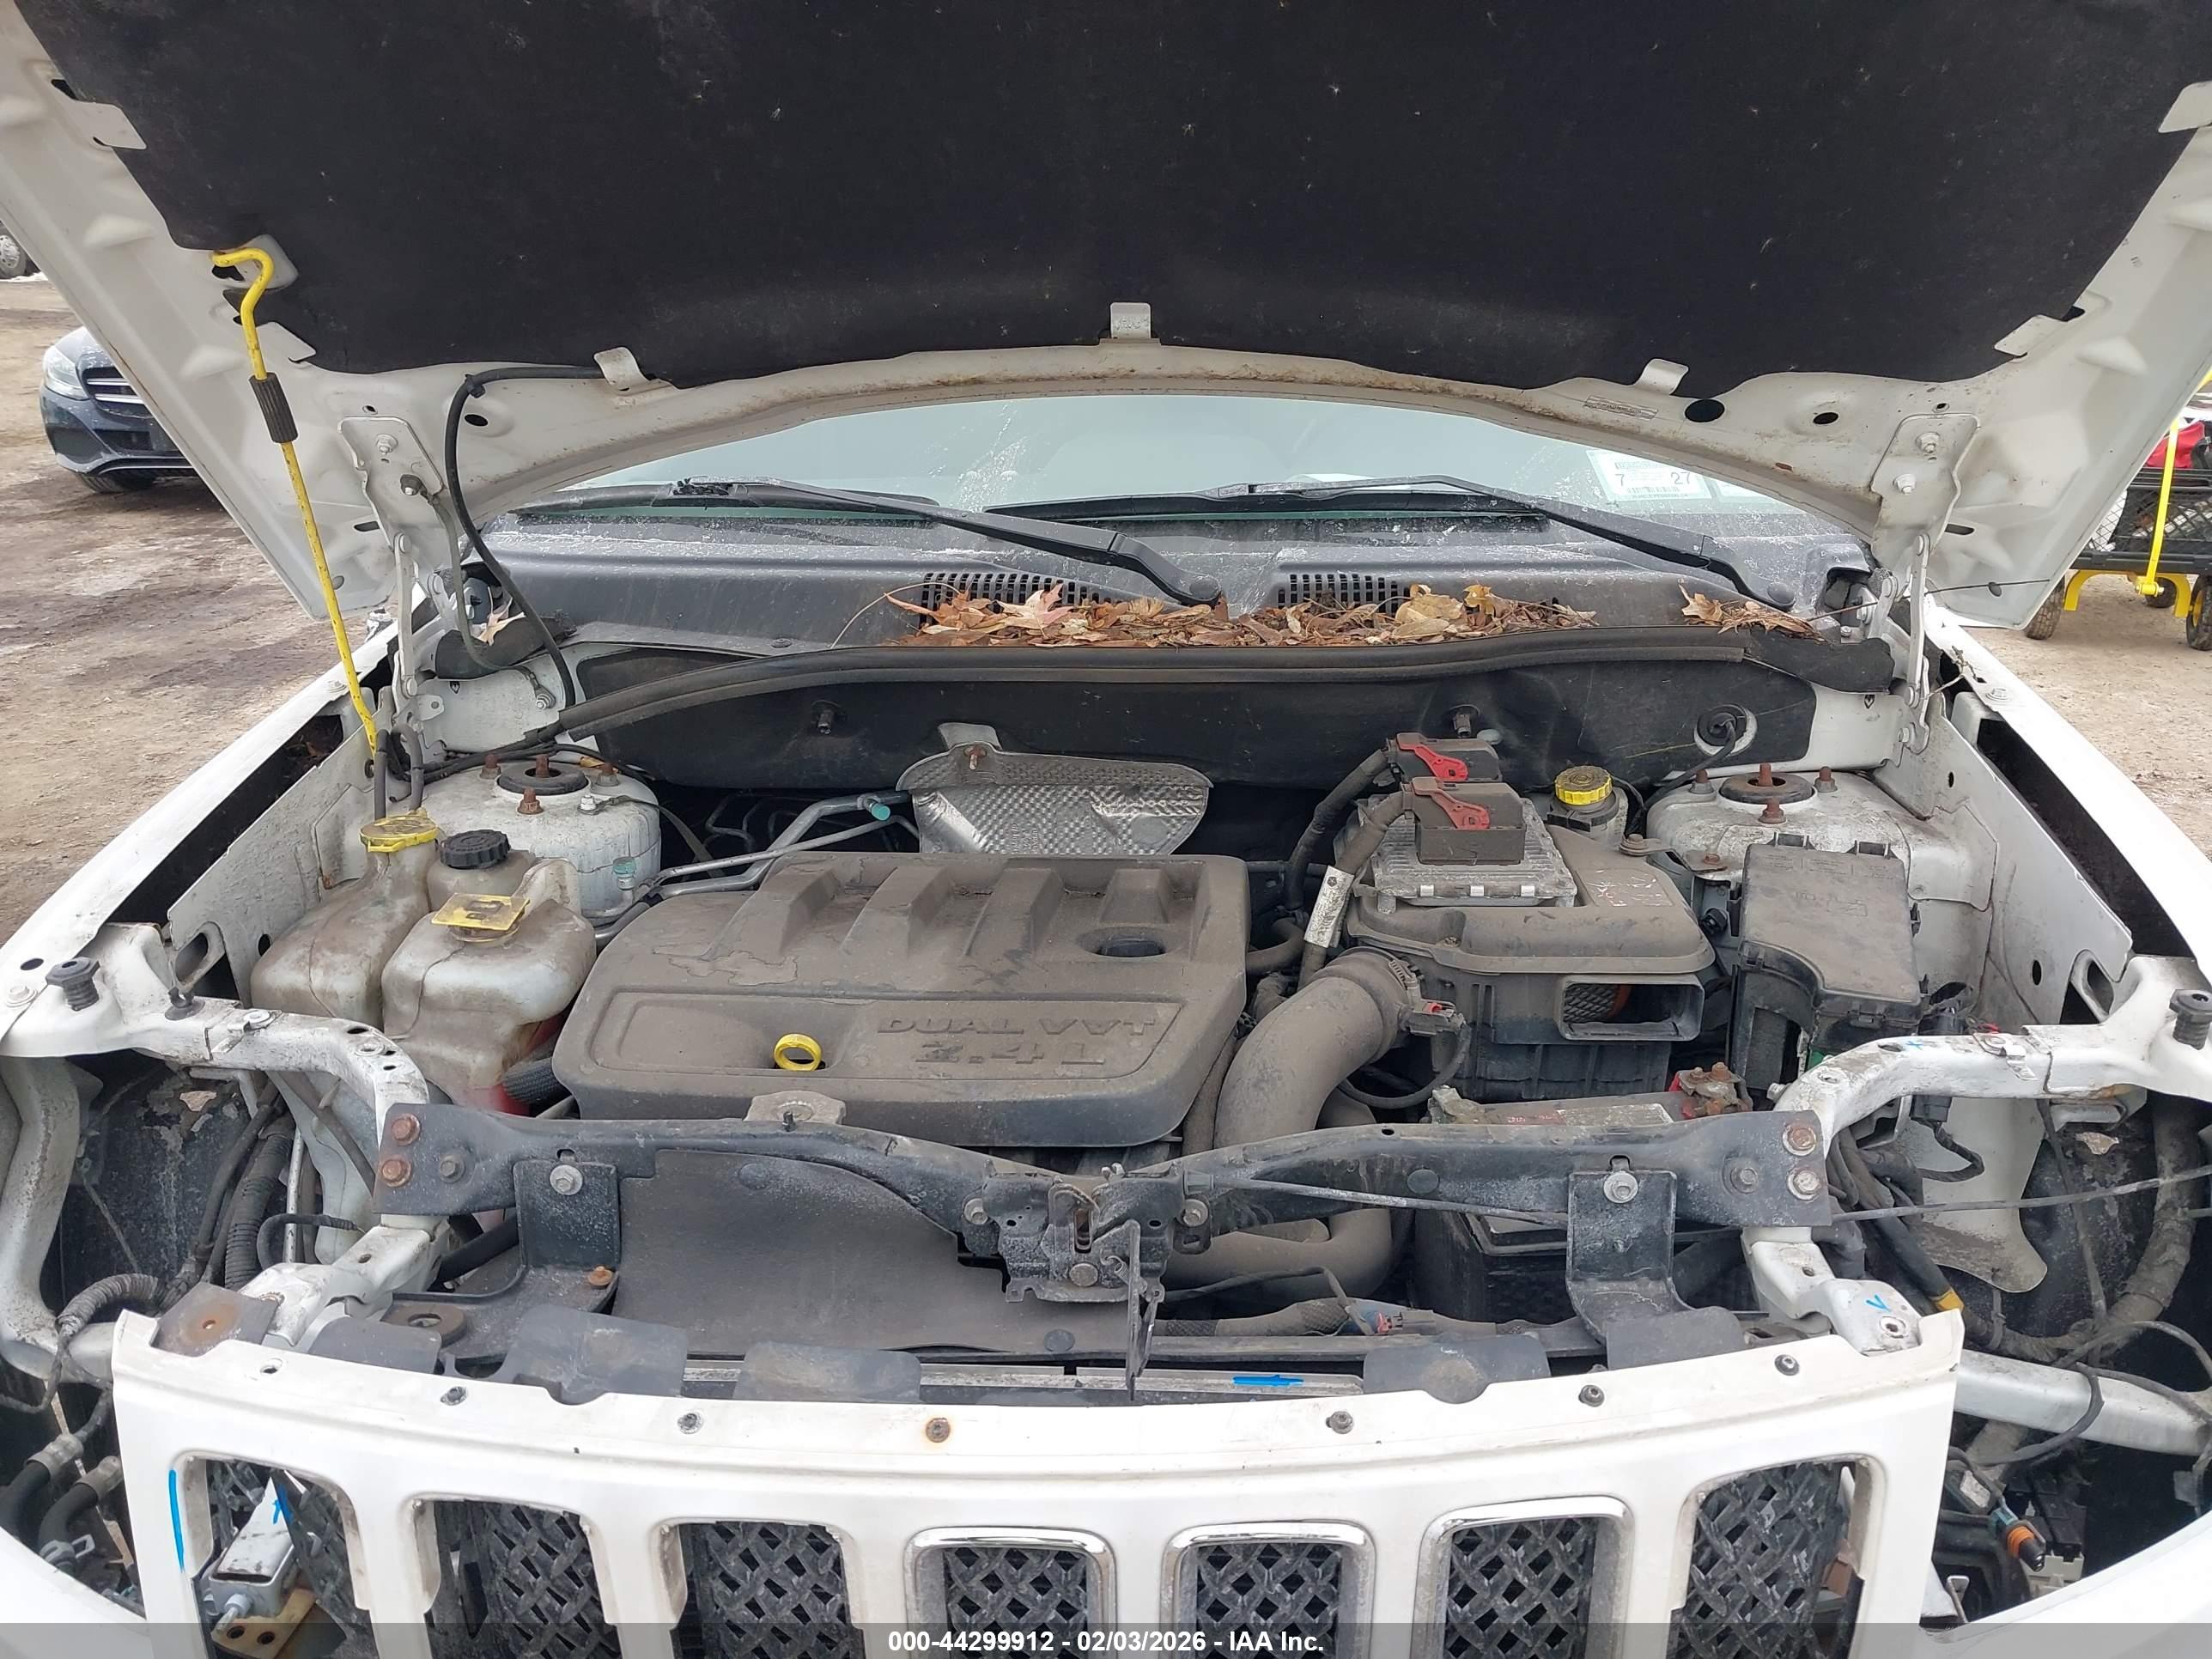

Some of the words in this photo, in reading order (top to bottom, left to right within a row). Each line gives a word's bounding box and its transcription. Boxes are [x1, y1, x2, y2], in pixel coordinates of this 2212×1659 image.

[1614, 473, 1626, 487] 7
[1670, 471, 1691, 485] 27
[877, 1017, 1024, 1035] DUAL
[1038, 1018, 1156, 1036] VVT
